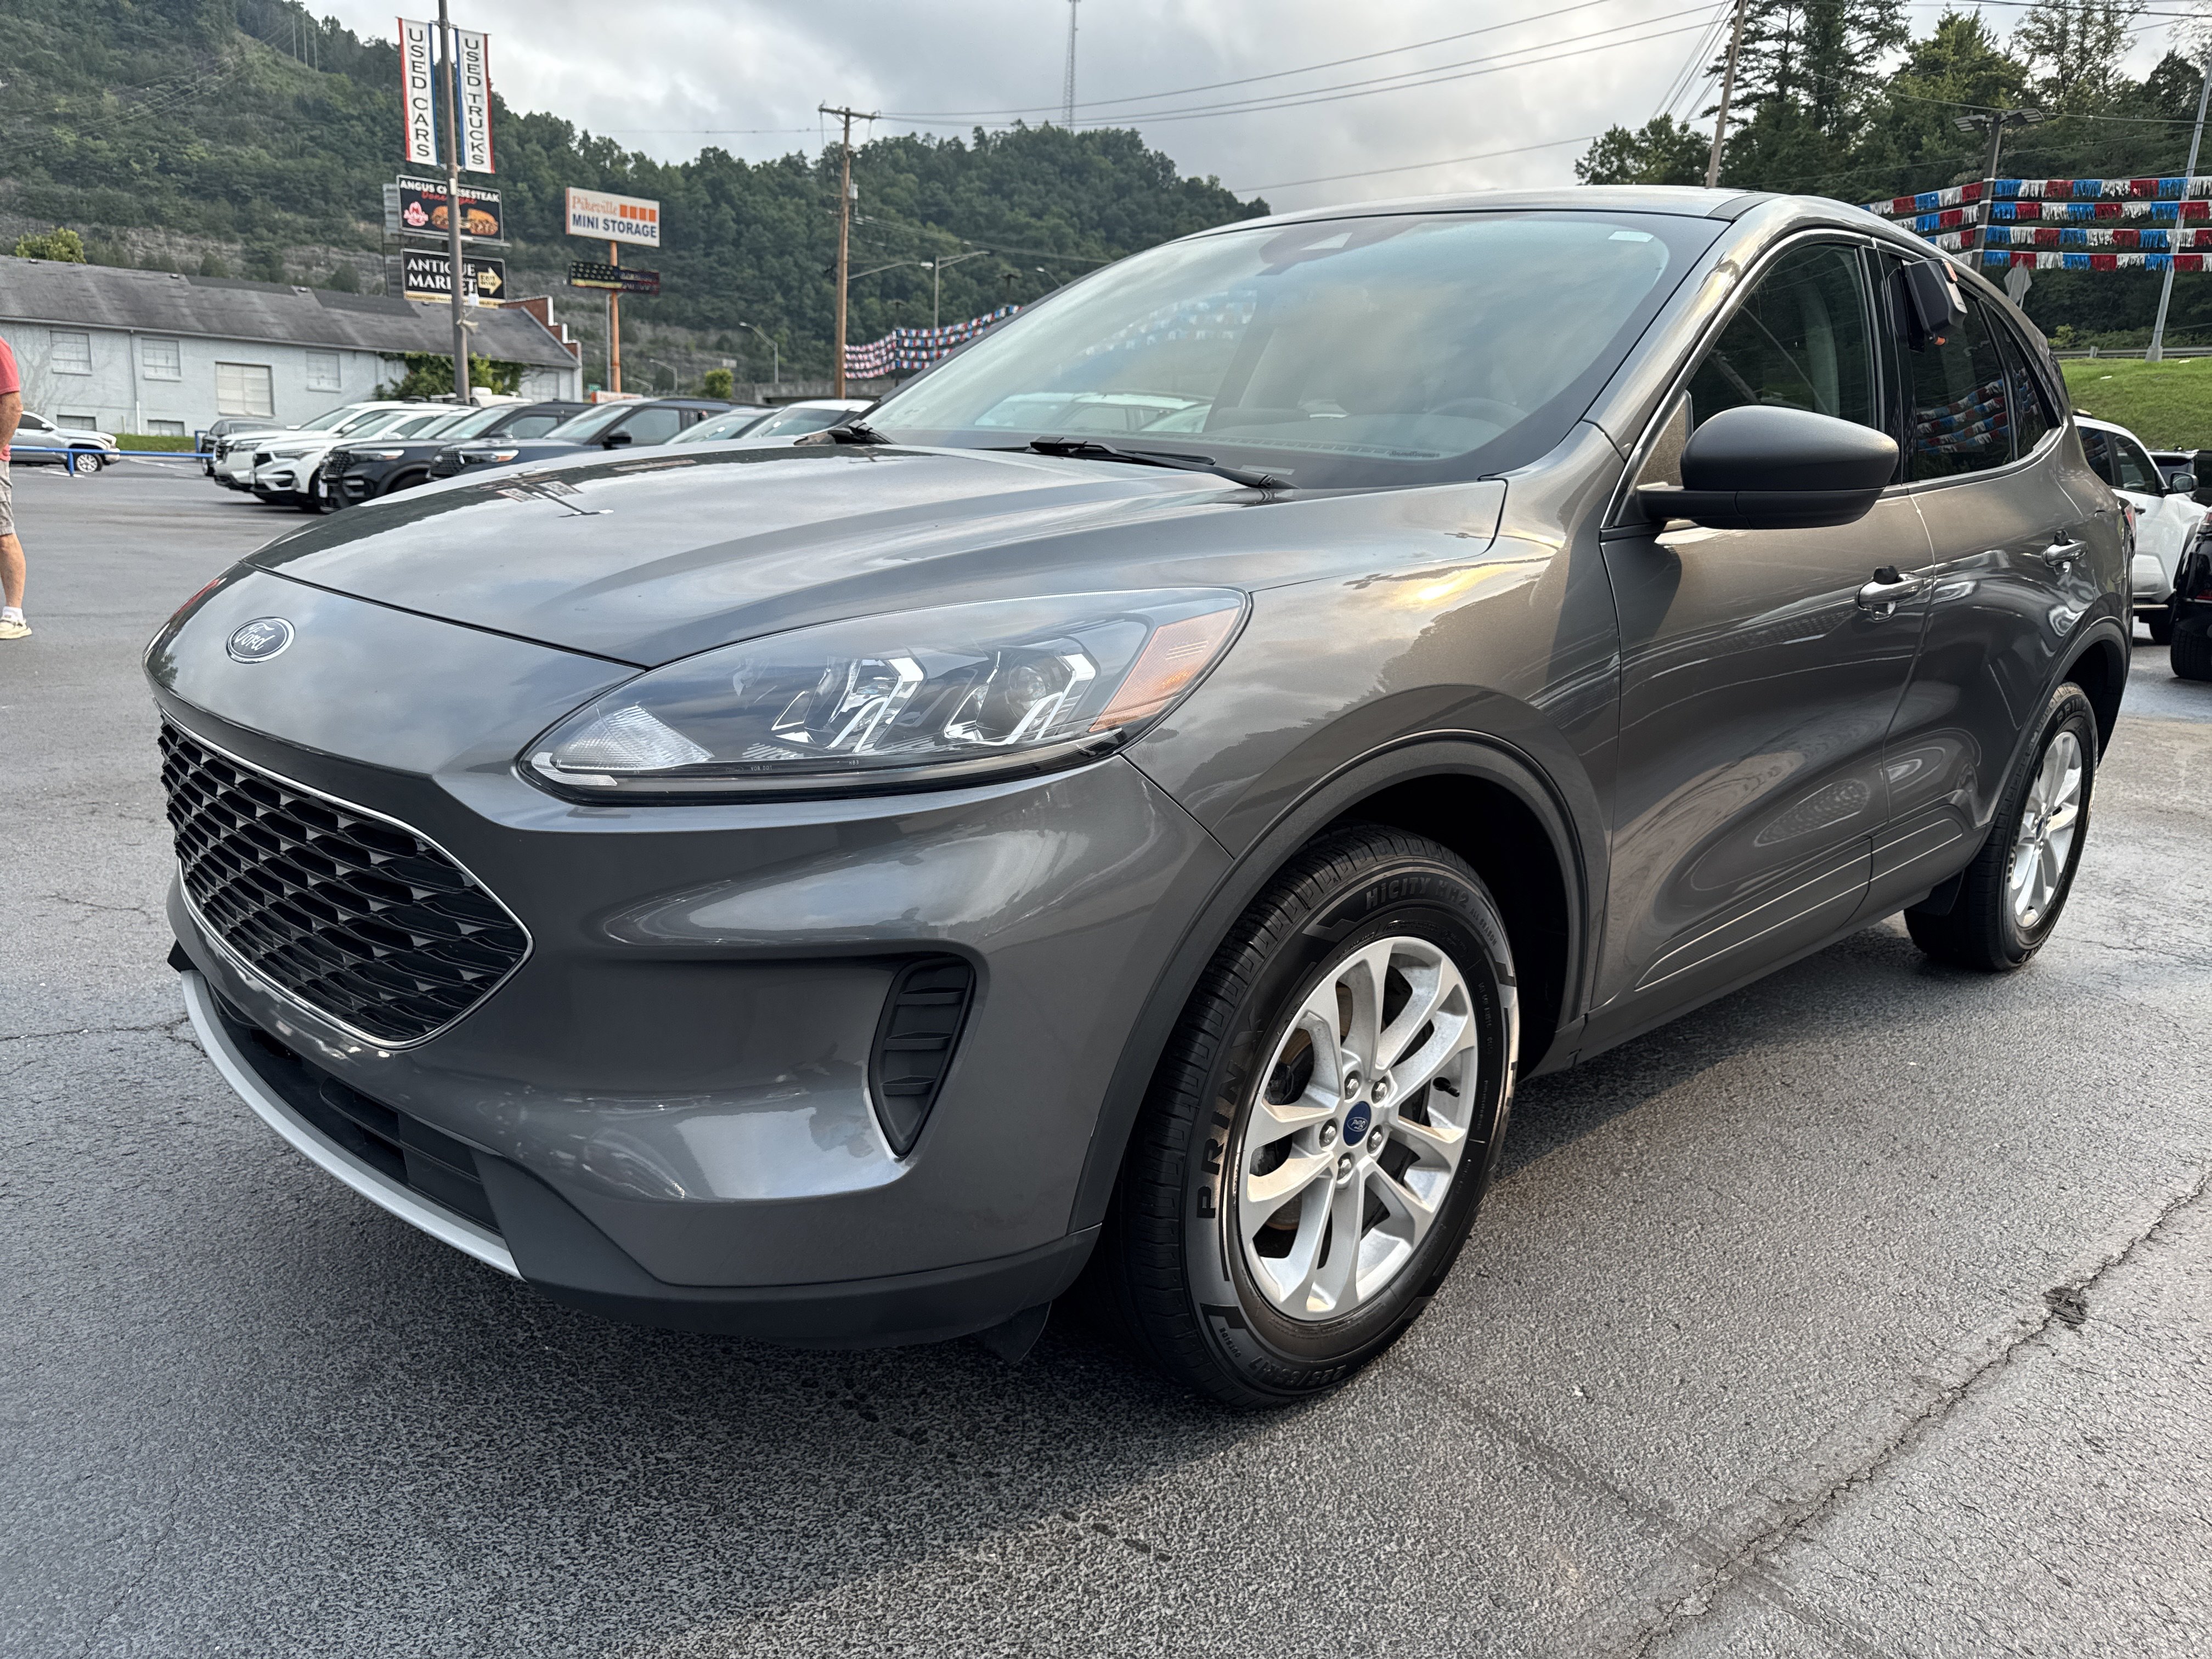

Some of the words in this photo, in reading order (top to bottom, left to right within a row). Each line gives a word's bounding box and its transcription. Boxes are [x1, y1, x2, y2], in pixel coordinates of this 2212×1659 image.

[409, 28, 427, 89] USED
[465, 38, 481, 87] USED
[413, 97, 430, 157] CARS
[468, 93, 484, 165] TRUCKS
[400, 179, 435, 193] ANGUS
[572, 213, 599, 229] MINI
[602, 218, 657, 238] STORAGE
[407, 257, 476, 277] ANTIE
[234, 622, 276, 651] Ford
[1479, 918, 1497, 946] SEASON
[1196, 1005, 1263, 1218] PRINX
[1218, 1327, 1242, 1358] OUTSIDE
